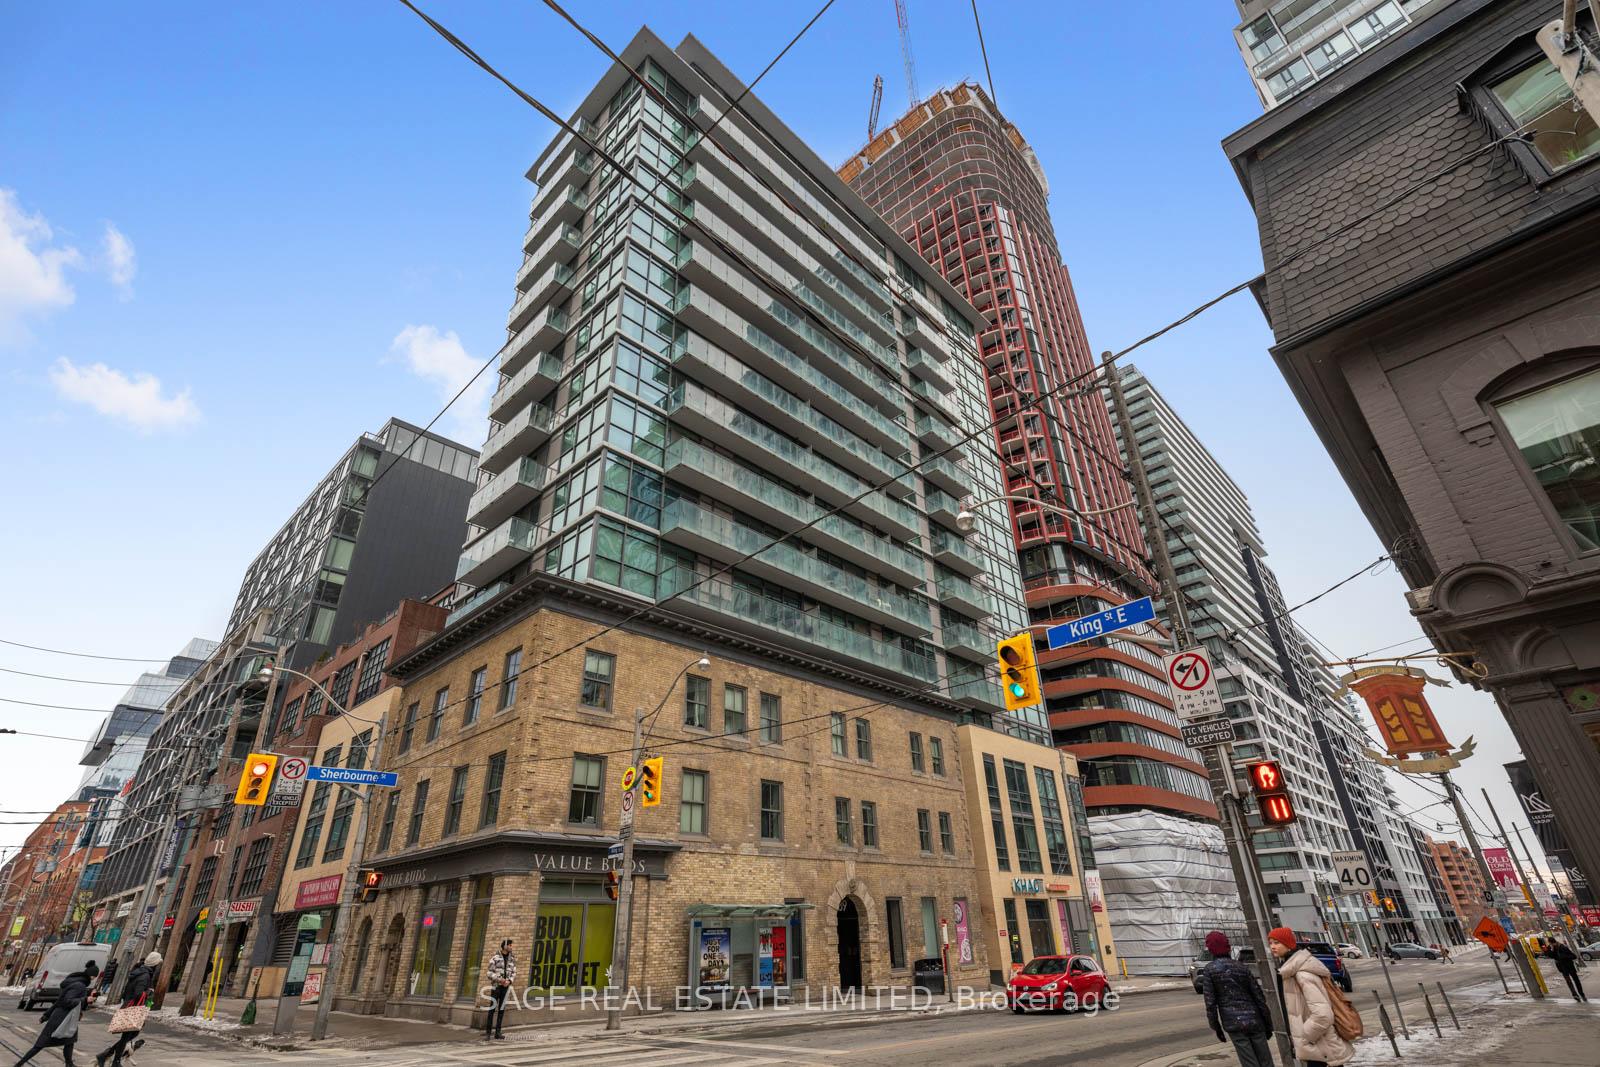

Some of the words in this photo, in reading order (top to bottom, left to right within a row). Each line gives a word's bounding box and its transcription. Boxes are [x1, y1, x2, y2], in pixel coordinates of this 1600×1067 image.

[1070, 618, 1102, 638] King
[1104, 612, 1113, 621] St
[1116, 607, 1127, 623] E
[1200, 689, 1205, 697] 9
[1180, 703, 1185, 711] 4
[1182, 726, 1196, 737] TTC
[1197, 721, 1231, 734] VEHICLES
[1187, 731, 1231, 746] EXCEPTED
[320, 768, 378, 782] Sherbourne
[534, 853, 592, 871] VALUE
[1334, 854, 1364, 862] MAXIMUM
[1487, 856, 1510, 864] OLD
[1341, 867, 1371, 886] 40
[230, 902, 255, 912] SUSHI
[536, 916, 571, 939] BUD
[533, 940, 557, 964] ON
[559, 940, 572, 963] A
[530, 962, 600, 989] BUDGET
